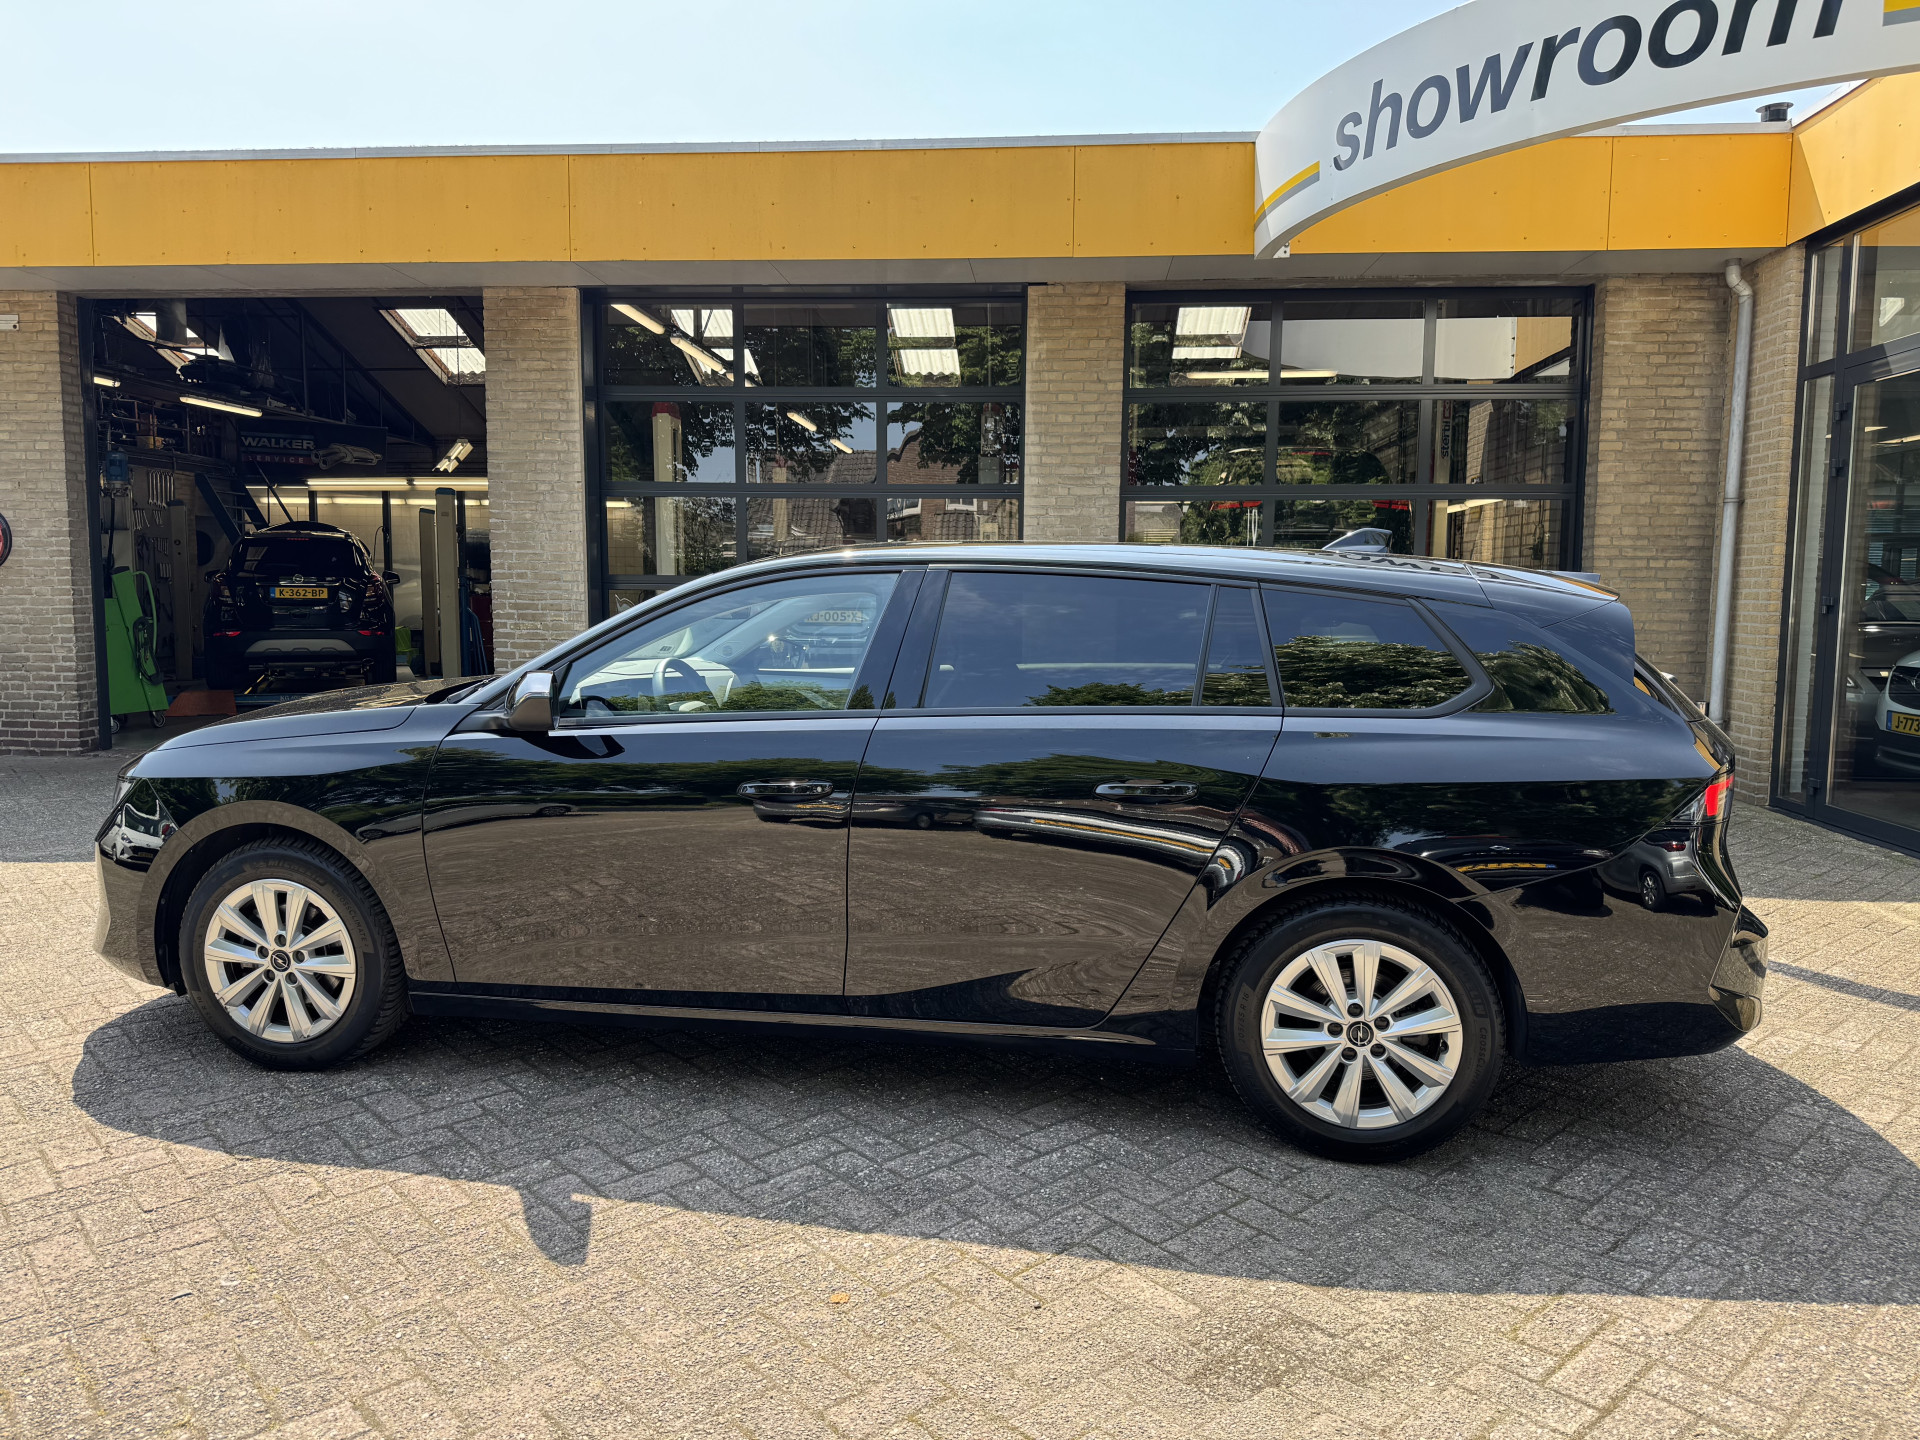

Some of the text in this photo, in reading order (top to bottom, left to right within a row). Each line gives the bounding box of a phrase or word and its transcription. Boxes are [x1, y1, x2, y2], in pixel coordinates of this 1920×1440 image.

[1333, 0, 1843, 171] showroom
[241, 436, 316, 450] WALKER
[279, 588, 325, 598] K-362-BP
